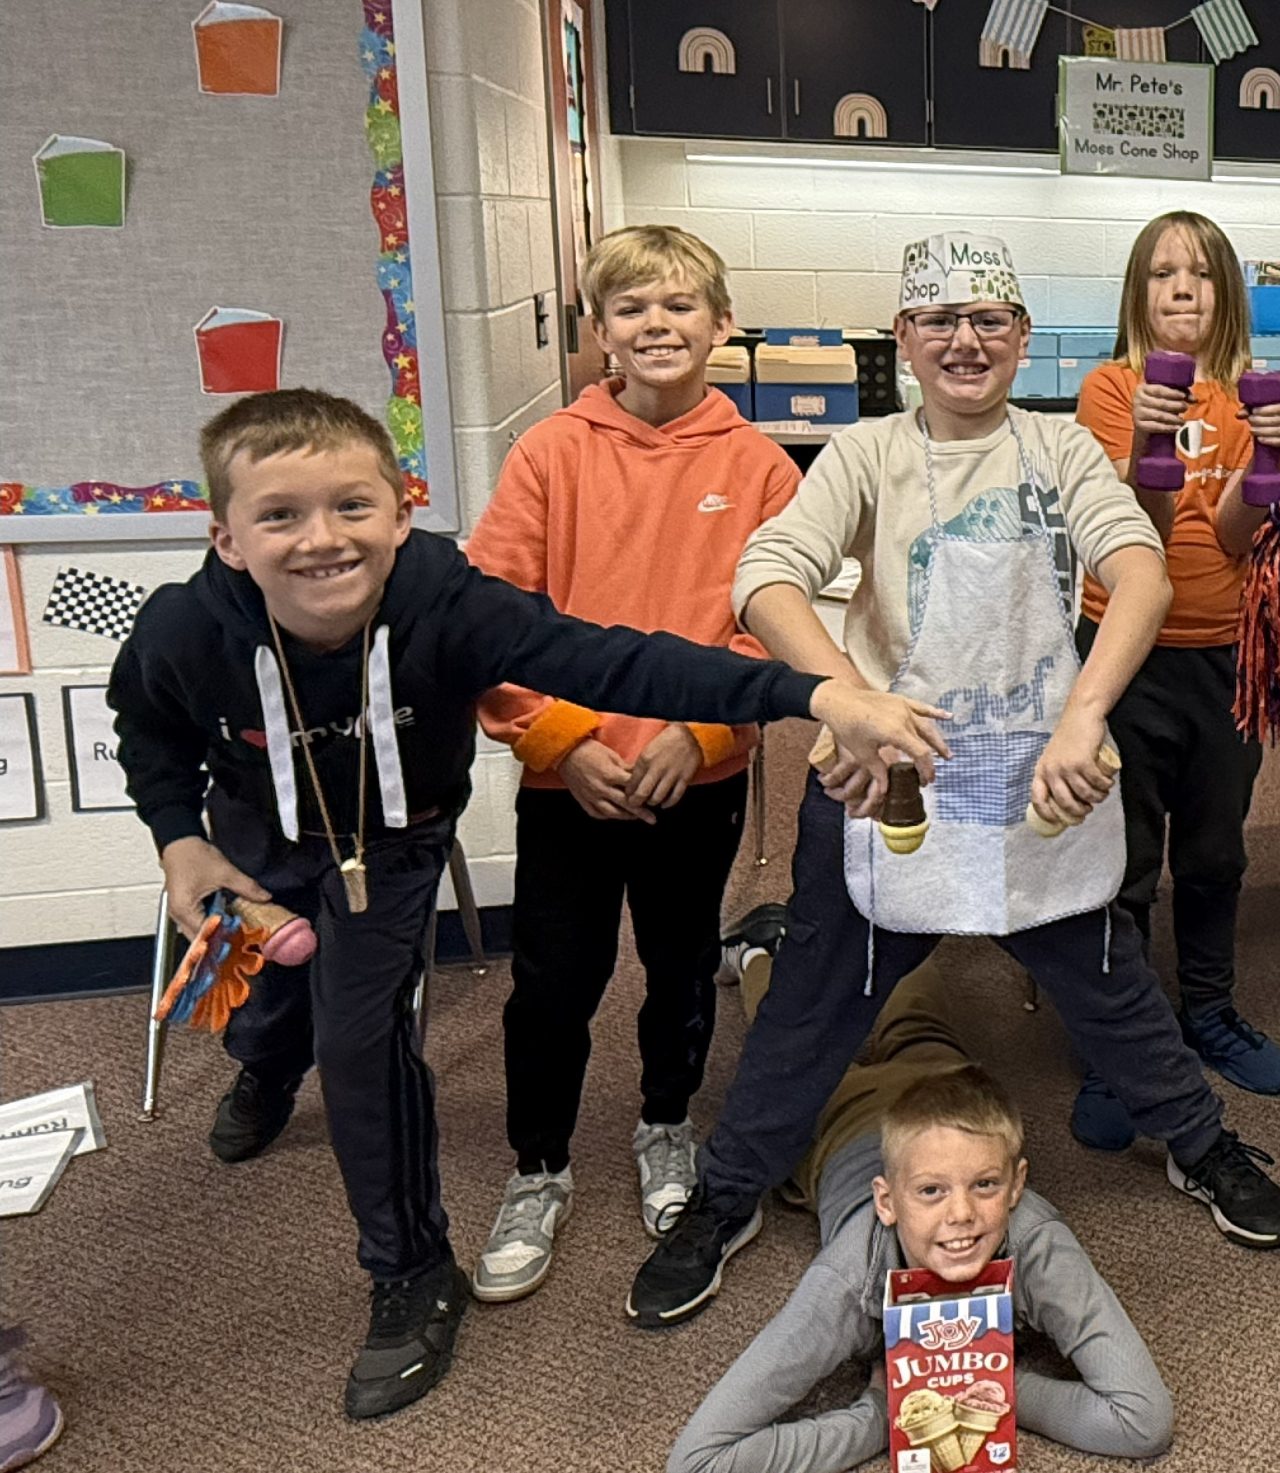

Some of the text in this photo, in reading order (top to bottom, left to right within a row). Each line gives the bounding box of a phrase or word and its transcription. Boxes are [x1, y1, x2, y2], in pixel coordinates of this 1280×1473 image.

[1095, 72, 1184, 96] Mr. Pete's
[1074, 138, 1199, 164] Moss Cone Shop
[950, 241, 1001, 266] Moss
[904, 277, 941, 302] Shop
[93, 741, 118, 761] Ru
[892, 1351, 1009, 1389] JUMBO
[926, 1372, 975, 1389] CUPS
